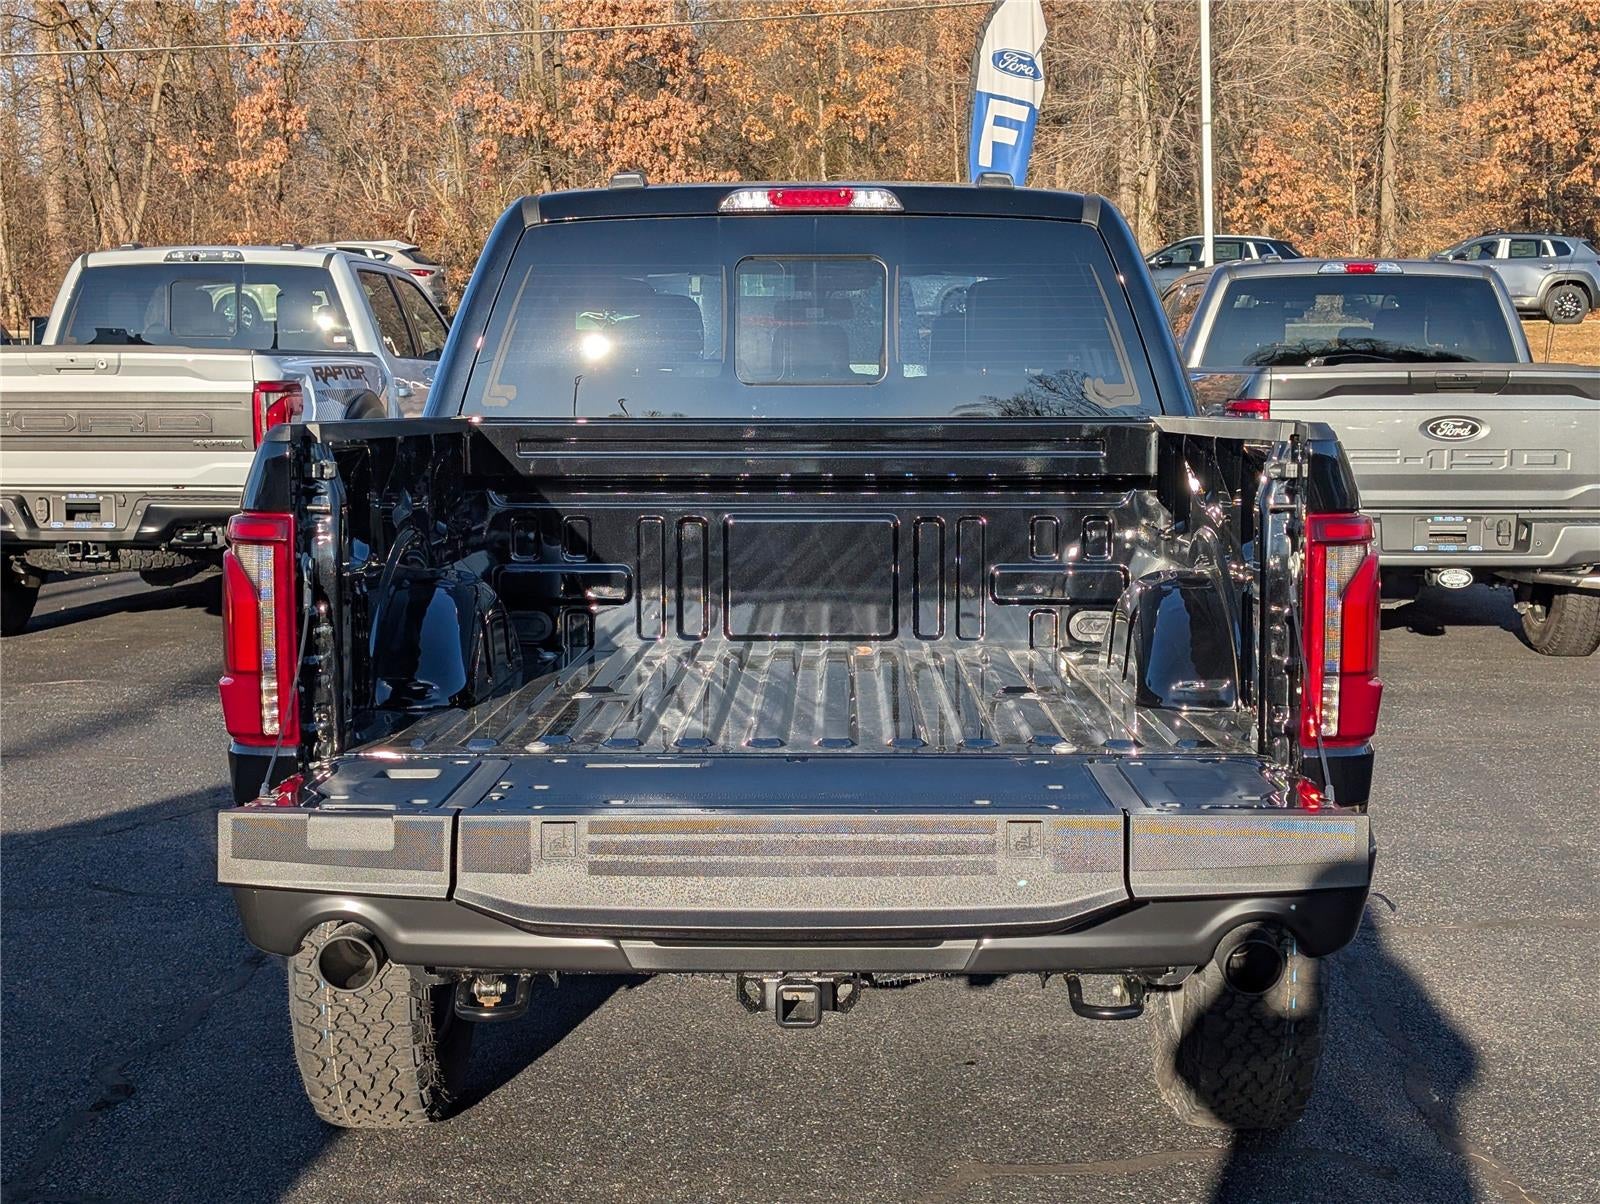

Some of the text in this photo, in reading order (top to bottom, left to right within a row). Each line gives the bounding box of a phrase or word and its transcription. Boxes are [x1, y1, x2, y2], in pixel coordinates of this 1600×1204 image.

[999, 52, 1035, 77] Ford
[311, 365, 370, 388] RAPTOR
[0, 411, 213, 433] ORD
[1436, 420, 1472, 437] Ford
